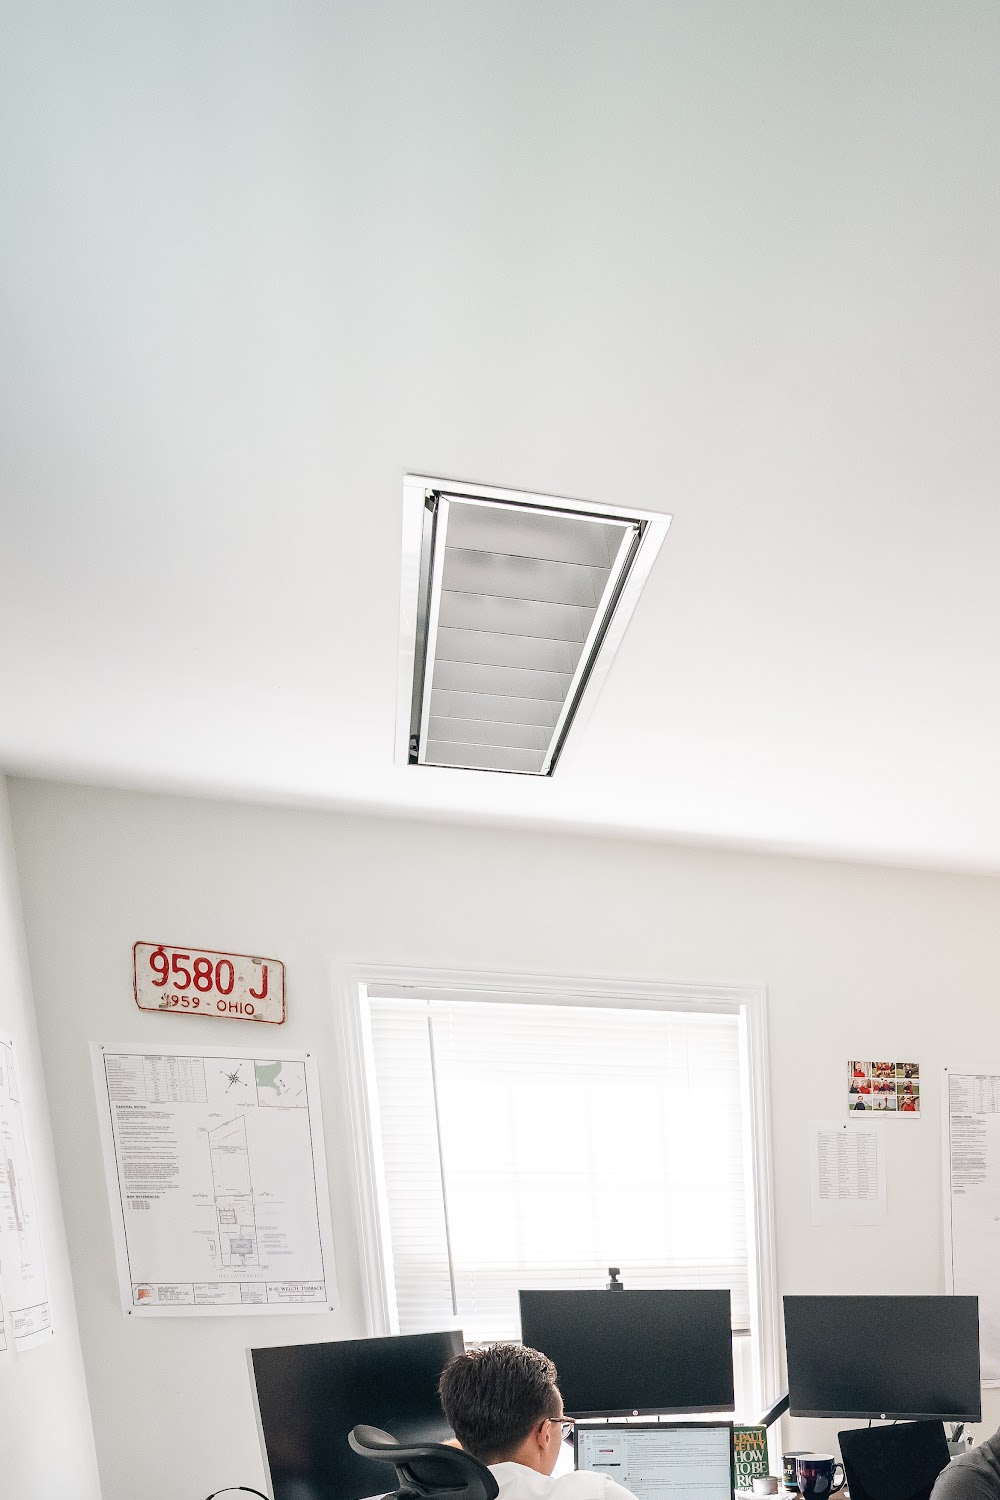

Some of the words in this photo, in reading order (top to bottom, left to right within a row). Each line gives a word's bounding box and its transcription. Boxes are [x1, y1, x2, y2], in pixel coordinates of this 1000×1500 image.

[149, 949, 235, 995] 9580
[248, 965, 268, 999] J
[216, 1000, 255, 1015] OHIO
[734, 1450, 764, 1463] HOW
[735, 1462, 751, 1475] TO
[751, 1461, 768, 1474] BE
